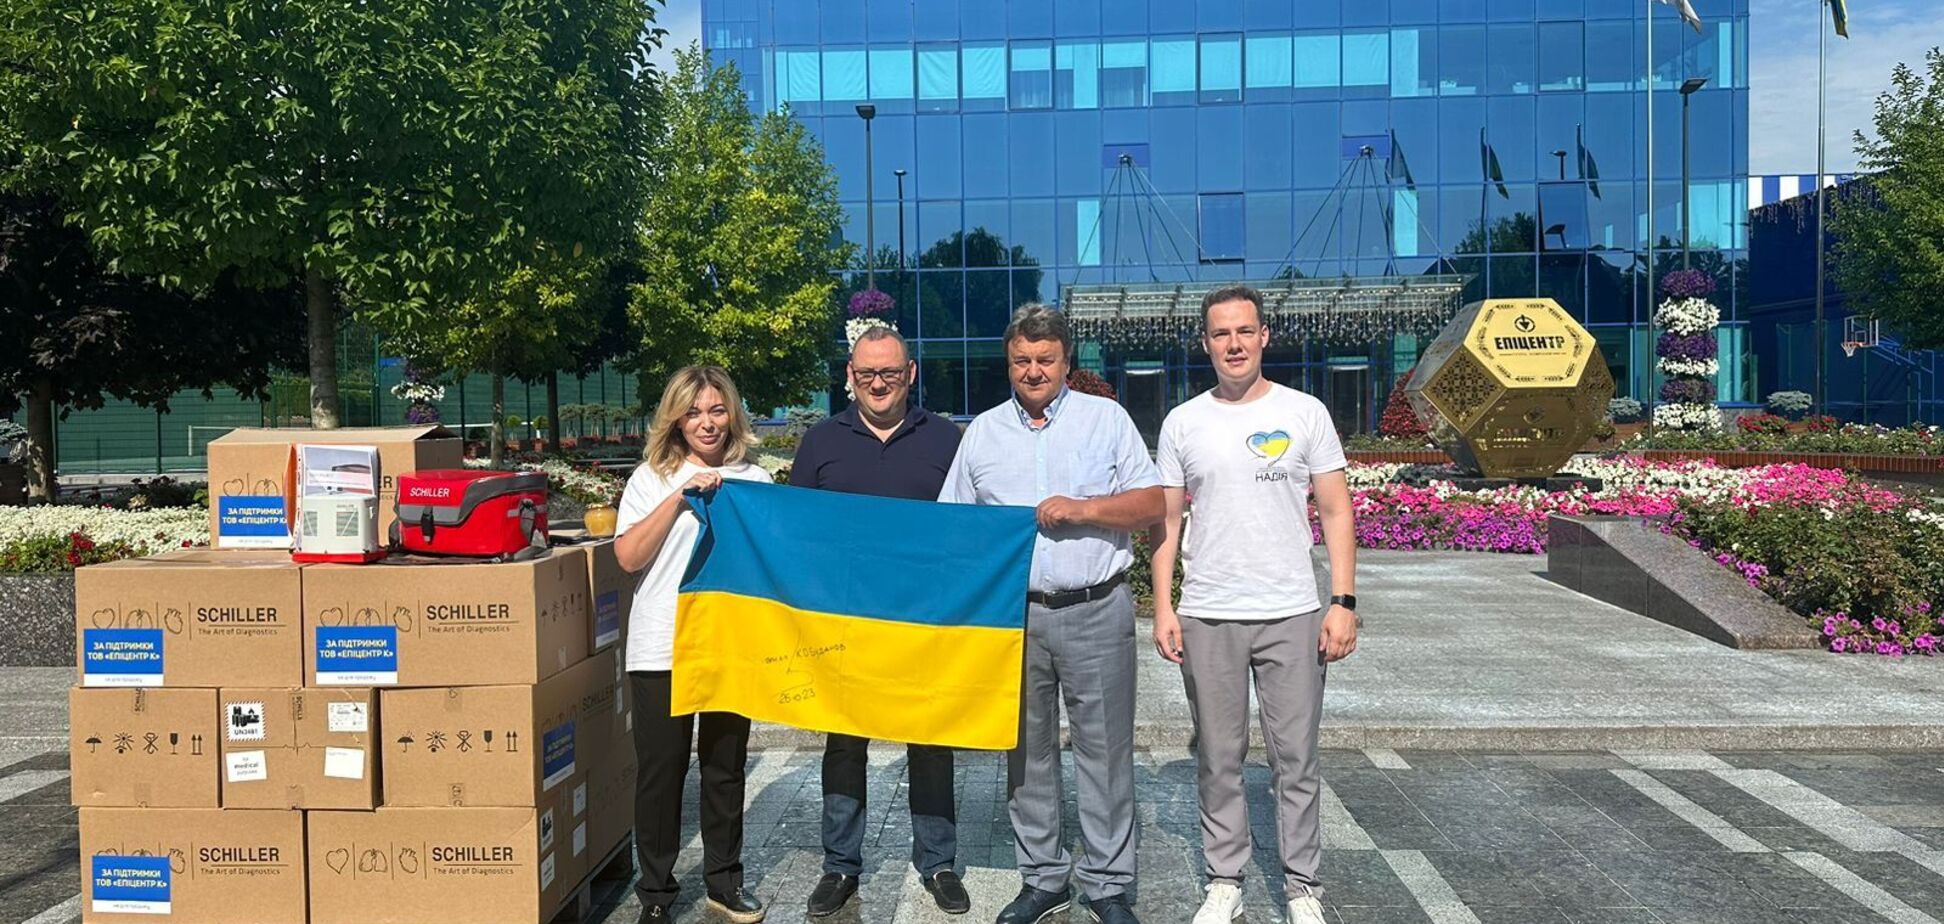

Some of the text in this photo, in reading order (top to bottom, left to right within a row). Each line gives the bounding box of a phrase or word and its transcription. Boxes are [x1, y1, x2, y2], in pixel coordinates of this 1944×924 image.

[1494, 336, 1565, 350] ЕПІЦЕНТР
[1255, 472, 1288, 482] НАДІЯ
[410, 487, 450, 498] SCHILLER
[227, 507, 283, 516] ЗА ПІДТРИМКИ
[197, 607, 277, 622] SCHILLER
[426, 604, 509, 620] SCHILLER
[226, 627, 235, 635] of
[236, 628, 278, 637] Diagnostics
[456, 625, 465, 633] of
[467, 625, 510, 634] Diagnostics
[93, 641, 154, 651] ЗА ПІДТРИМКИ
[326, 639, 387, 649] ЗА ПІДТРИМКИ
[87, 651, 103, 660] ТОВ
[105, 652, 149, 661] «ЕПІЦЕНТР
[320, 650, 336, 658] ТОВ
[337, 650, 382, 659] «ЕПІЦЕНТР
[199, 847, 280, 862] SCHILLER
[432, 847, 513, 861] SCHILLER
[101, 868, 161, 878] ЗА ПІДТРИМКИ
[229, 867, 238, 875] of
[239, 868, 280, 876] Diagnostics
[433, 867, 446, 875] The
[472, 867, 514, 876] Diagnostics
[95, 878, 112, 887] ТОВ
[112, 879, 157, 888] «ЕПІЦЕНТР
